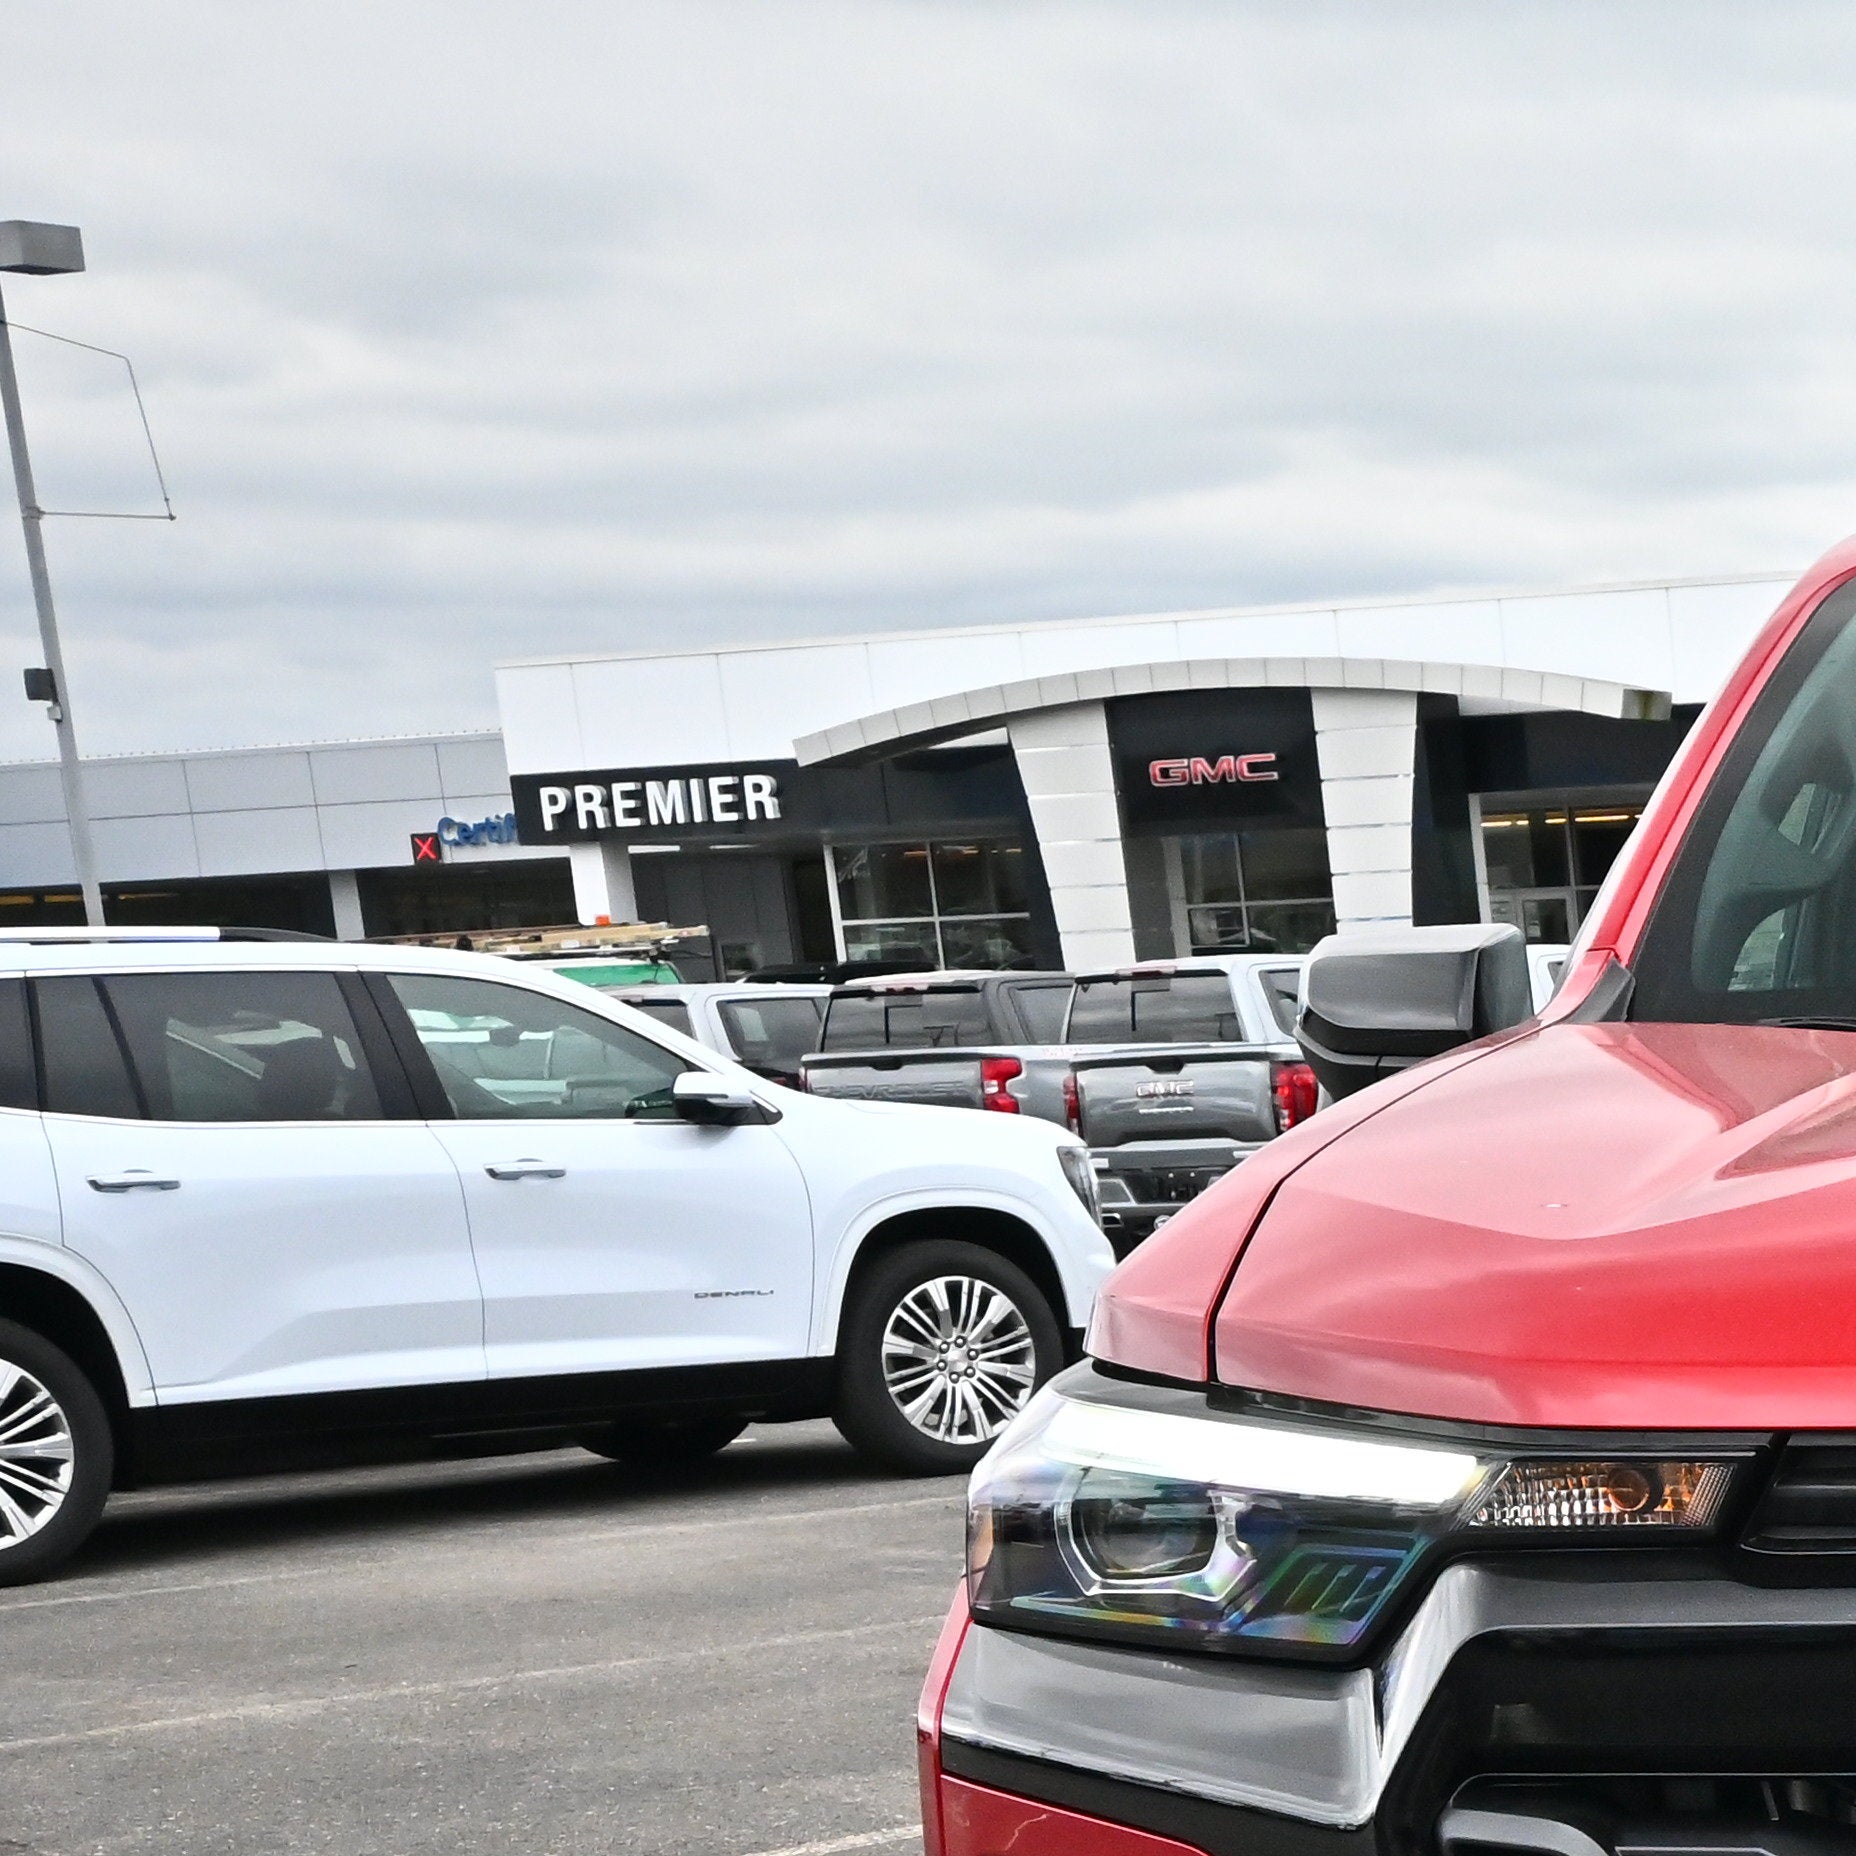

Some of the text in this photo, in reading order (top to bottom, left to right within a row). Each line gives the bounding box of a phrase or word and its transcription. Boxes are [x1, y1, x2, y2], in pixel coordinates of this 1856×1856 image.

[1149, 752, 1279, 787] GMC
[539, 774, 781, 832] PREMIER
[694, 1289, 774, 1299] DENALI
